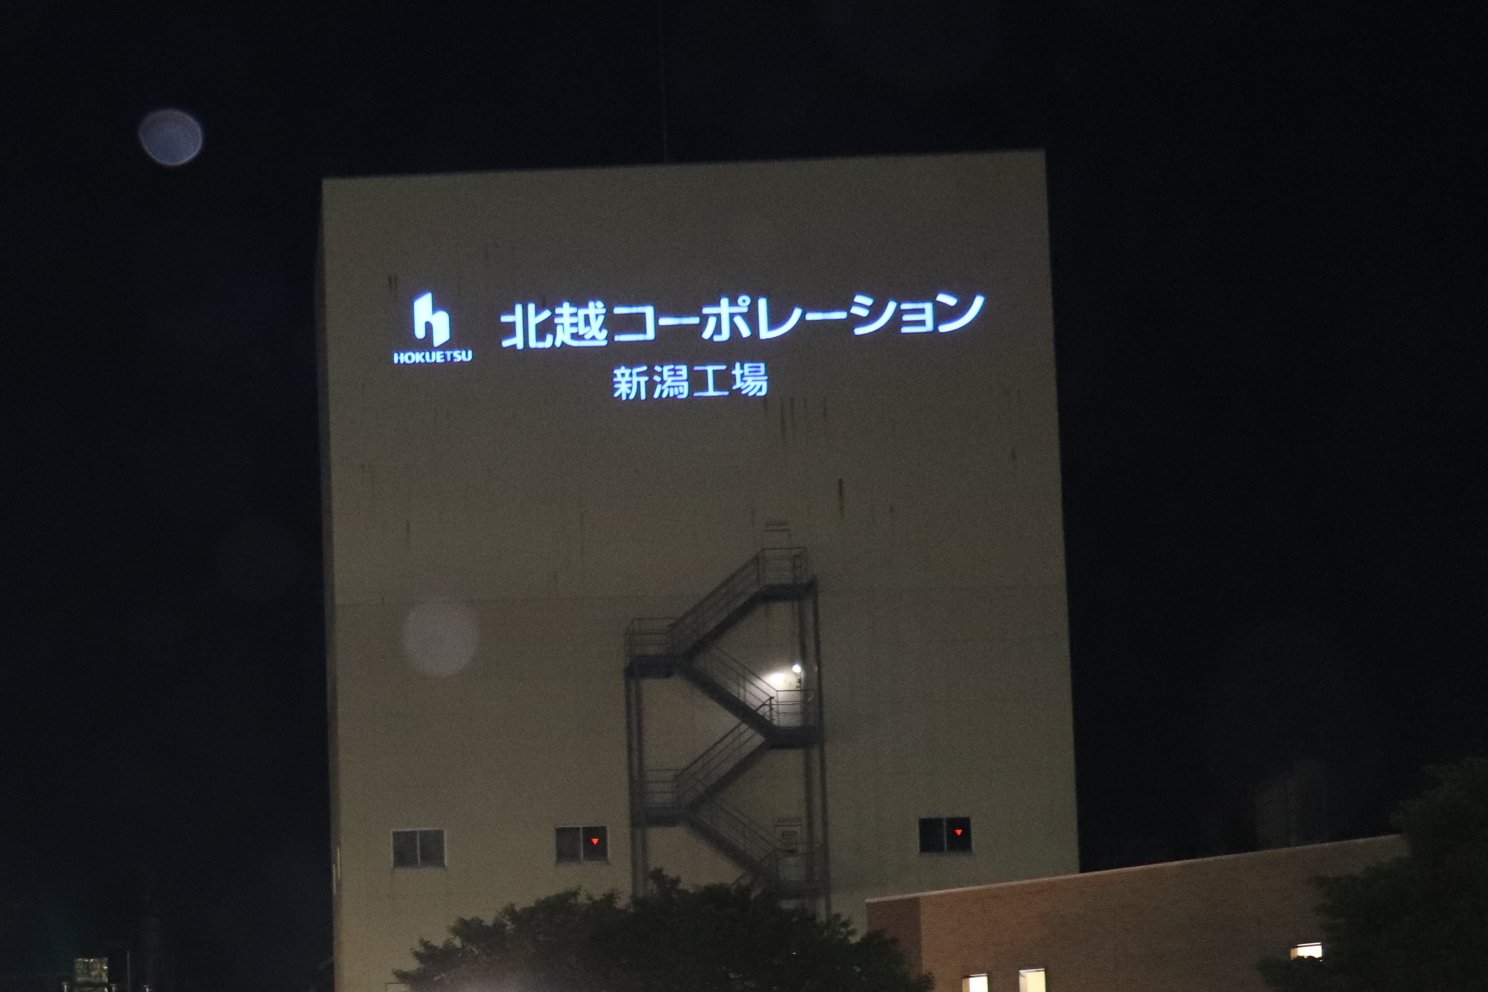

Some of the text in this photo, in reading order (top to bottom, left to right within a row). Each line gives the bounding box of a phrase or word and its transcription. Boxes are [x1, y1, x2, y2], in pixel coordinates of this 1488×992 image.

[500, 294, 985, 351] 北越コーポレーション
[393, 349, 473, 364] HOKUETSU
[612, 362, 769, 401] 新潟工場
